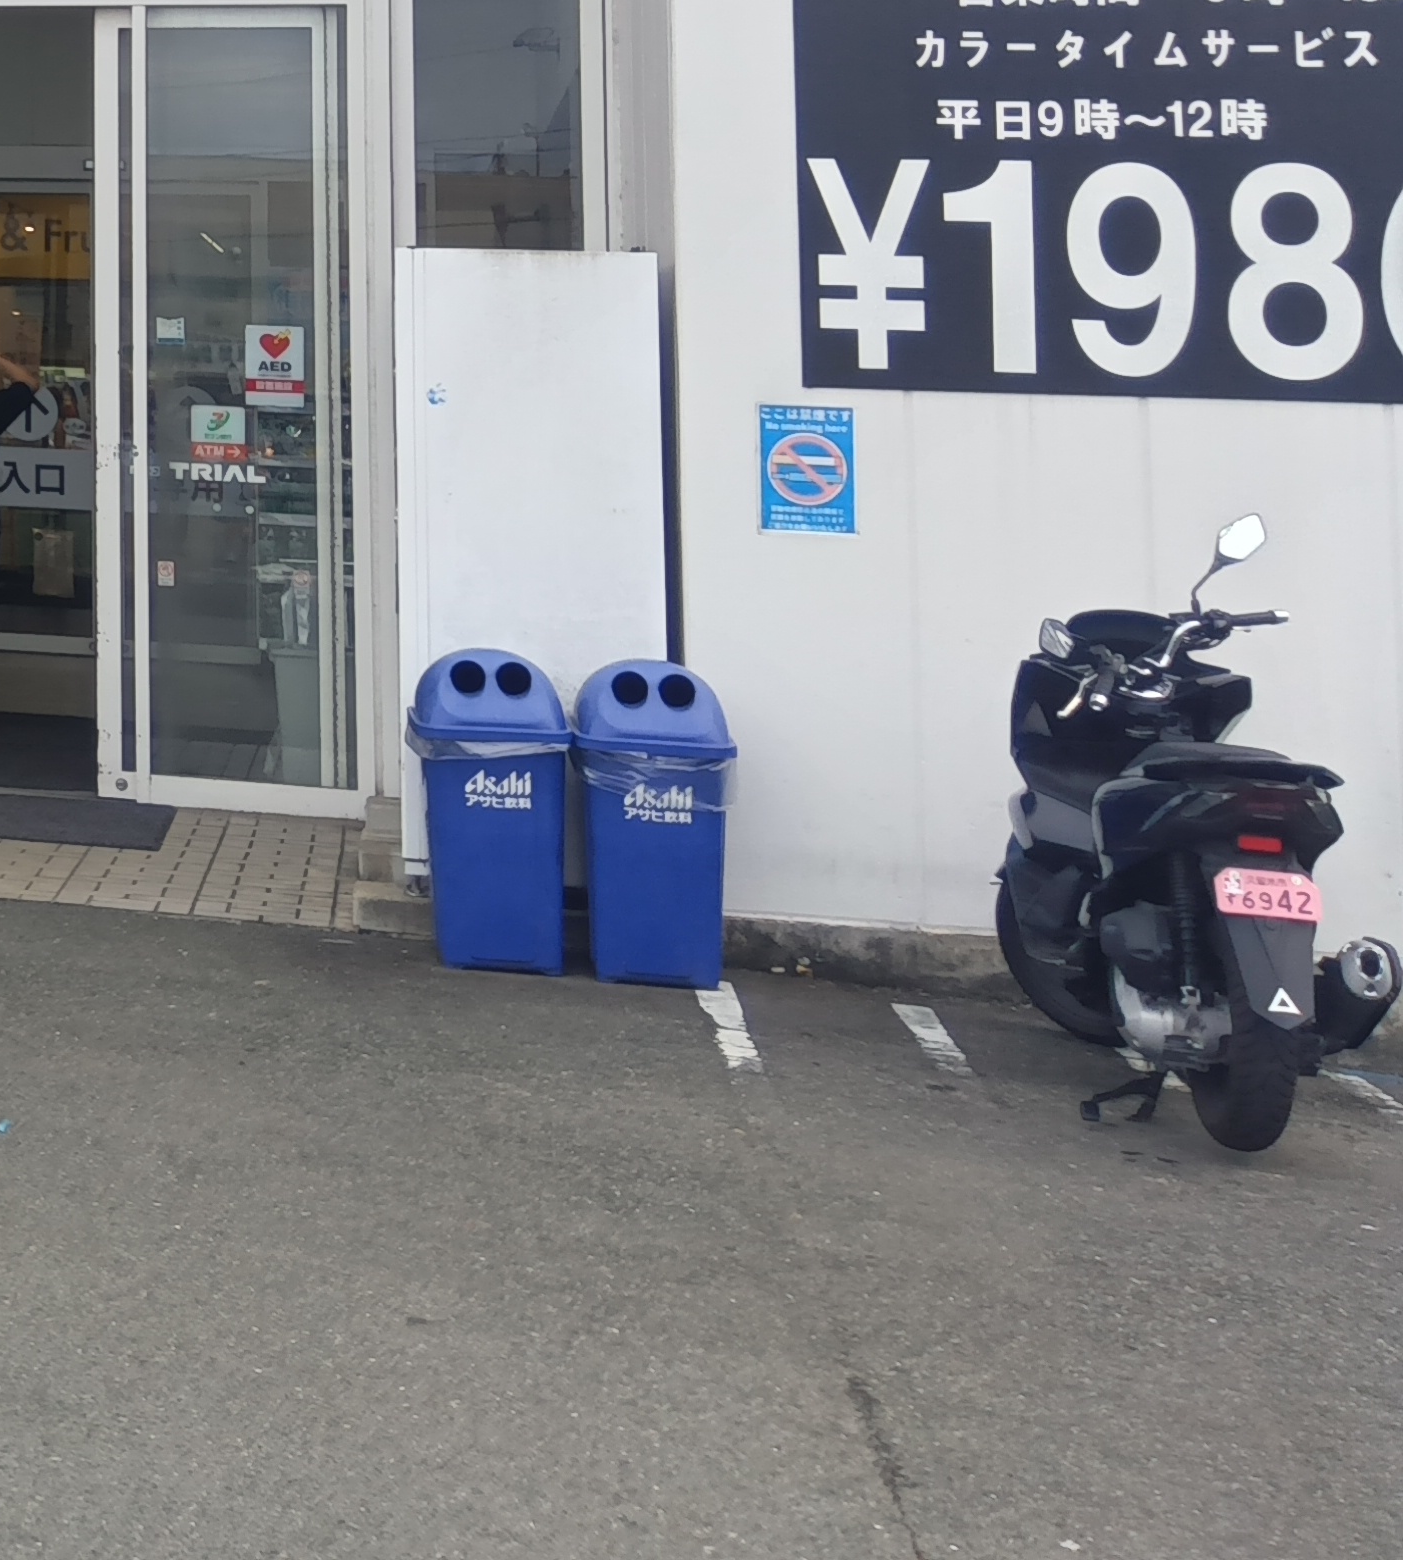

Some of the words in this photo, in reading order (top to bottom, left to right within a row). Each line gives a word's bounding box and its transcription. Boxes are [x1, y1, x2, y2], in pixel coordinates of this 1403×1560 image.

[916, 27, 1379, 69] カラータイムサービス
[806, 157, 1403, 382] ¥198
[258, 361, 292, 372] AED
[760, 407, 851, 423] ここは禁煙です
[764, 421, 780, 431] No
[780, 423, 823, 434] smoking
[824, 424, 849, 433] here
[195, 445, 225, 456] ATM
[169, 461, 267, 484] TRIAL
[464, 769, 532, 796] Asahi
[464, 794, 532, 810] アサヒ飲料
[623, 783, 693, 811] Asahi
[623, 806, 693, 825] アサヒ飲料
[1242, 890, 1313, 916] 6942
